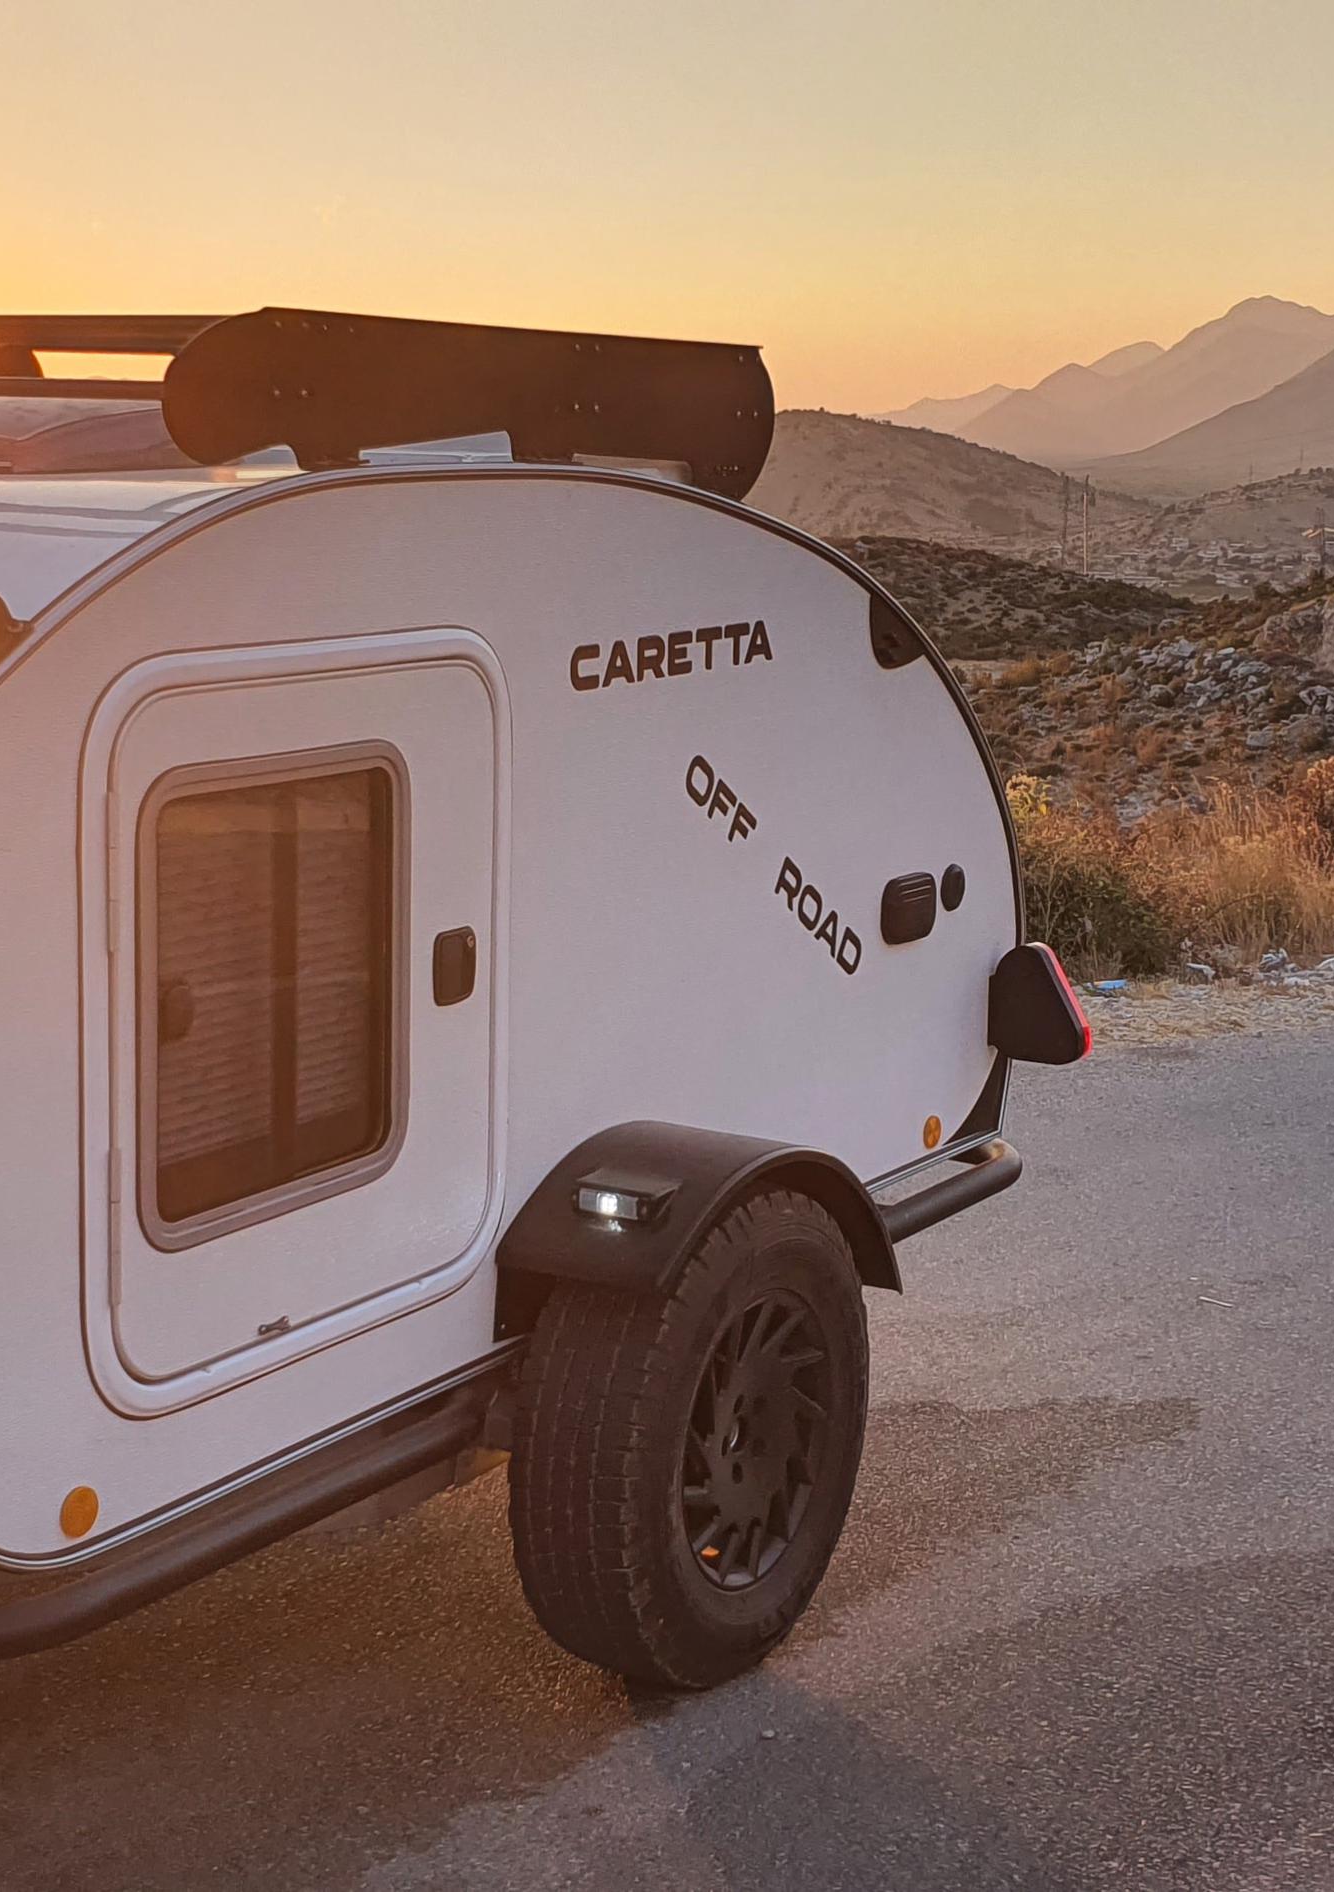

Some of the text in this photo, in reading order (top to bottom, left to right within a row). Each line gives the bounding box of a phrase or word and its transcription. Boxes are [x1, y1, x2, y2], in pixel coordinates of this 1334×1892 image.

[570, 620, 773, 691] CARETTA
[685, 755, 862, 976] OFF ROAD
